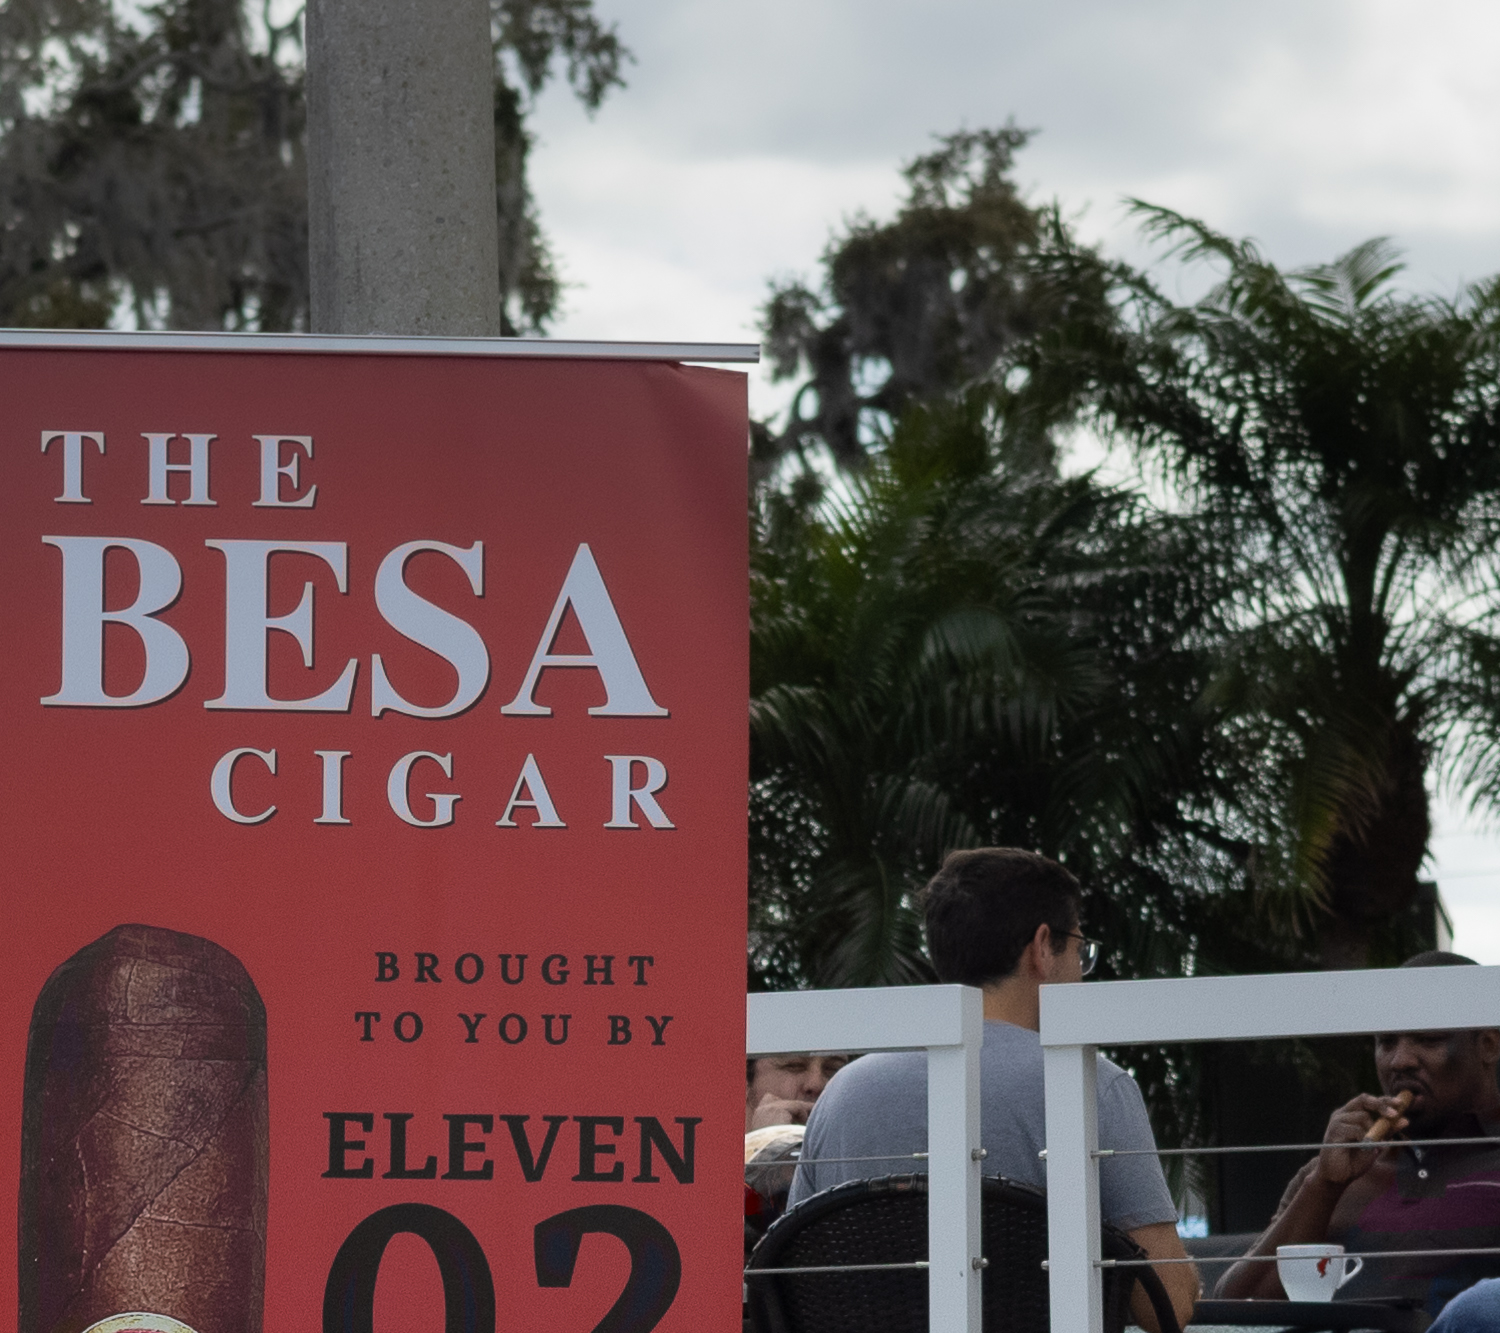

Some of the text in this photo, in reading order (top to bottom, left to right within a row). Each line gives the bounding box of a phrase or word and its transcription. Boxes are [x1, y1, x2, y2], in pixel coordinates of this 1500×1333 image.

[40, 430, 318, 509] THE
[39, 534, 671, 720] BESA
[209, 746, 676, 830] CIGAR
[374, 951, 656, 987] BROUGHT
[355, 1011, 674, 1047] TO YOU BY
[321, 1111, 703, 1185] ELEVEN
